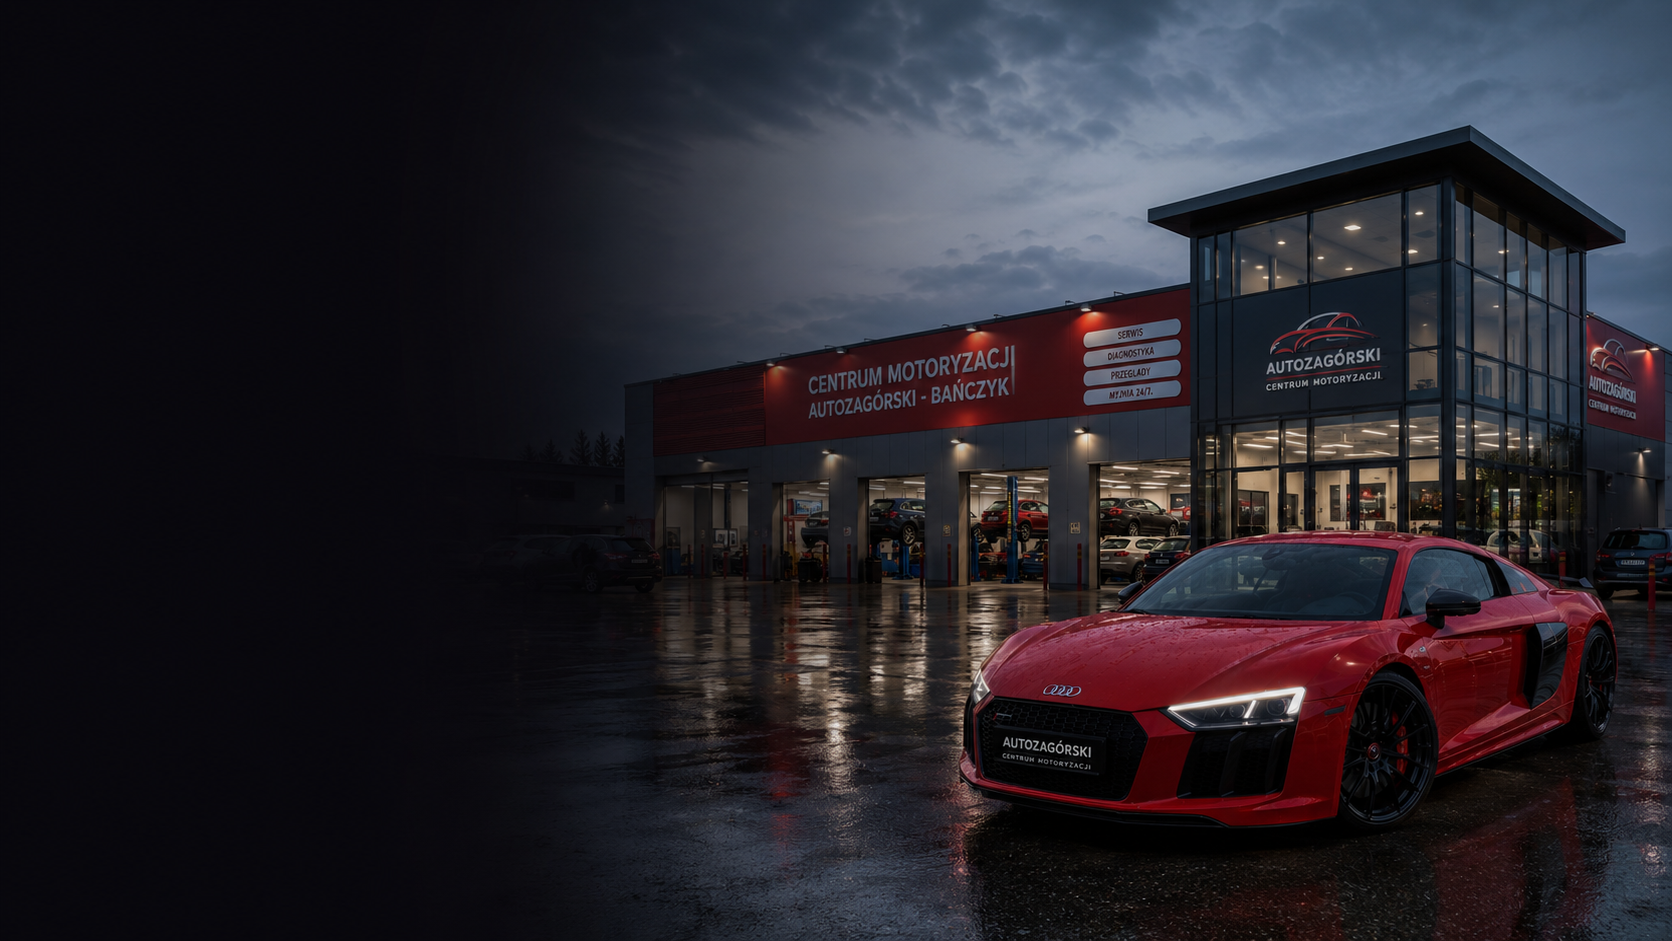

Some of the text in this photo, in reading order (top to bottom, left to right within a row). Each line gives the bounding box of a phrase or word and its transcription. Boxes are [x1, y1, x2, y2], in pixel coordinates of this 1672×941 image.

[1117, 328, 1144, 340] SERWIS
[1107, 346, 1155, 361] DIAGNOSTYKA
[1266, 347, 1381, 375] AUTOZAGÓRSKI
[808, 345, 1015, 395] CENTRUM MOTORYZACJI
[1266, 371, 1381, 392] CENTRUM MOTORYZACJI
[808, 389, 916, 419] AUTOZAGÓRSKI
[931, 377, 1009, 404] BAŃCZYK
[1003, 736, 1092, 758] AUTOZAGÓRSKI
[1002, 753, 1091, 770] CENTRUM MOTORYZACJI
